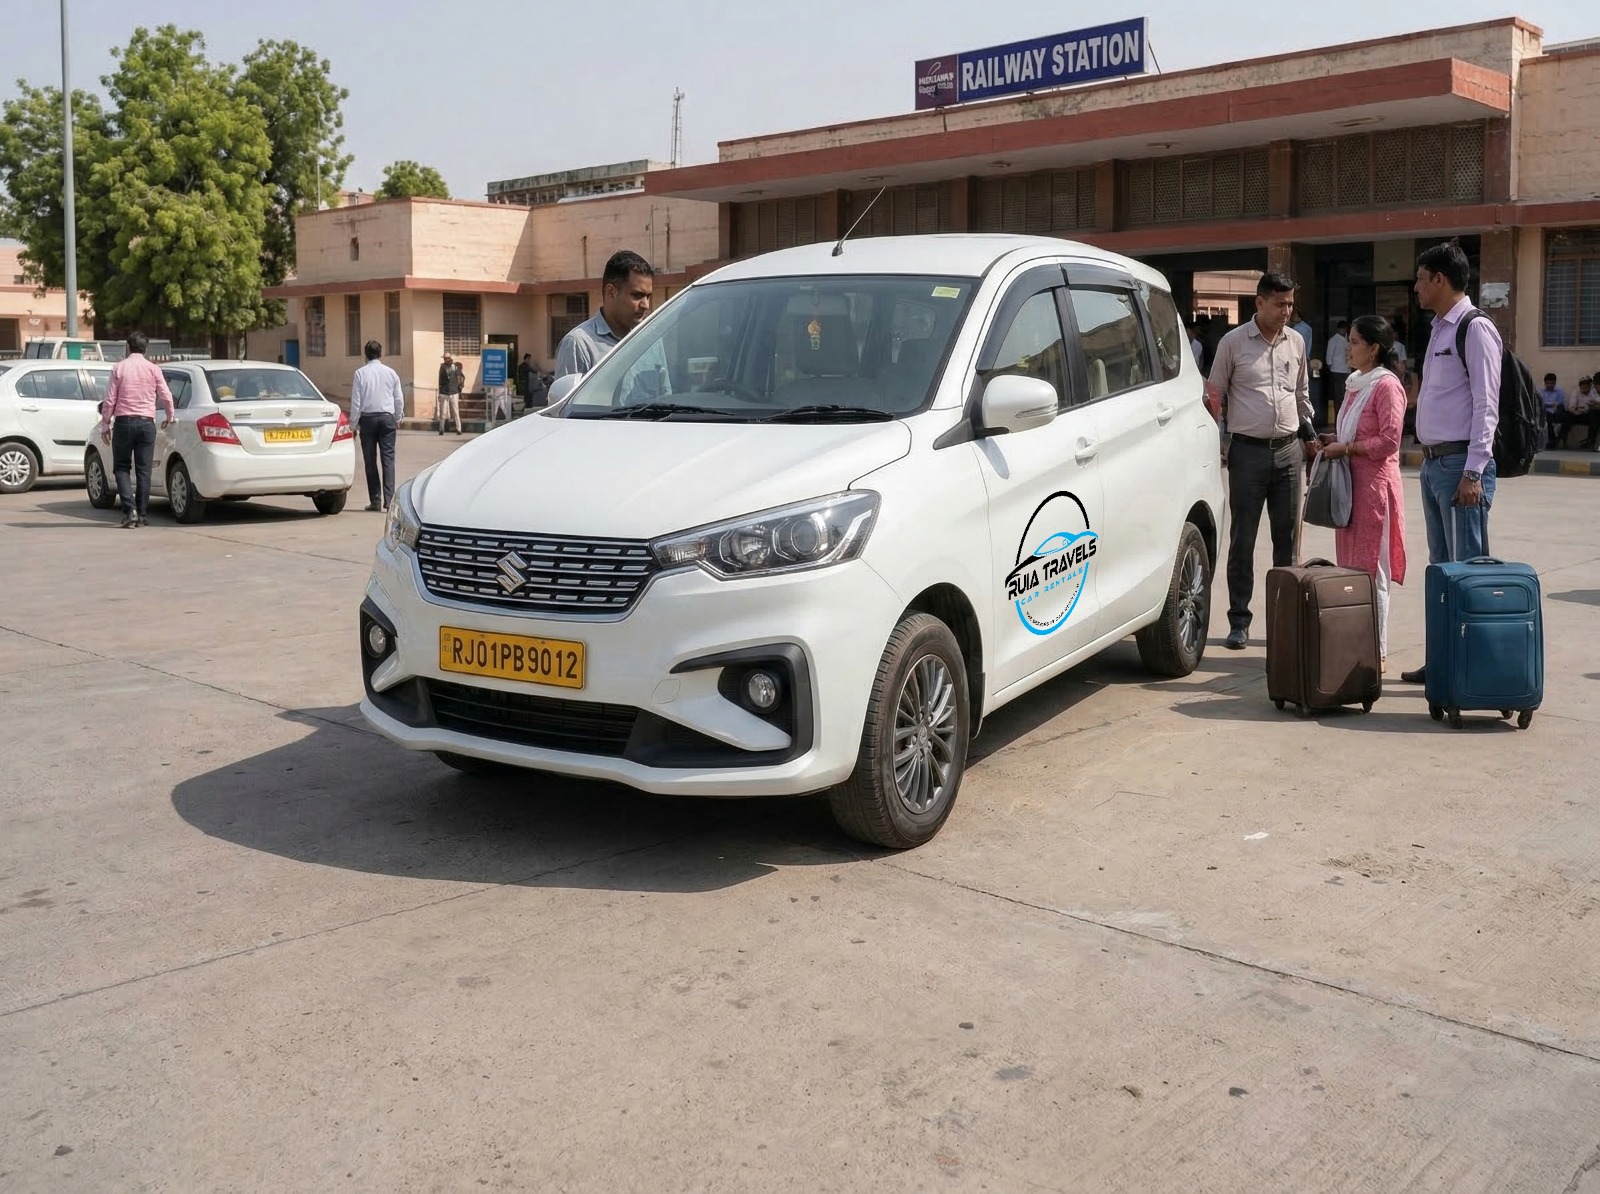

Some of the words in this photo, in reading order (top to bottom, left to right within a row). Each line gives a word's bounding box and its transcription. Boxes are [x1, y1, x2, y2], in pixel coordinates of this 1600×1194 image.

[962, 47, 1046, 91] RAILWAY
[1052, 30, 1139, 76] STATION
[1008, 569, 1039, 600] RUIA
[1043, 538, 1097, 581] TRAVELS
[1020, 591, 1039, 605] CAR
[1044, 567, 1083, 593] RENTALS
[453, 637, 577, 679] RJ01PB9012
